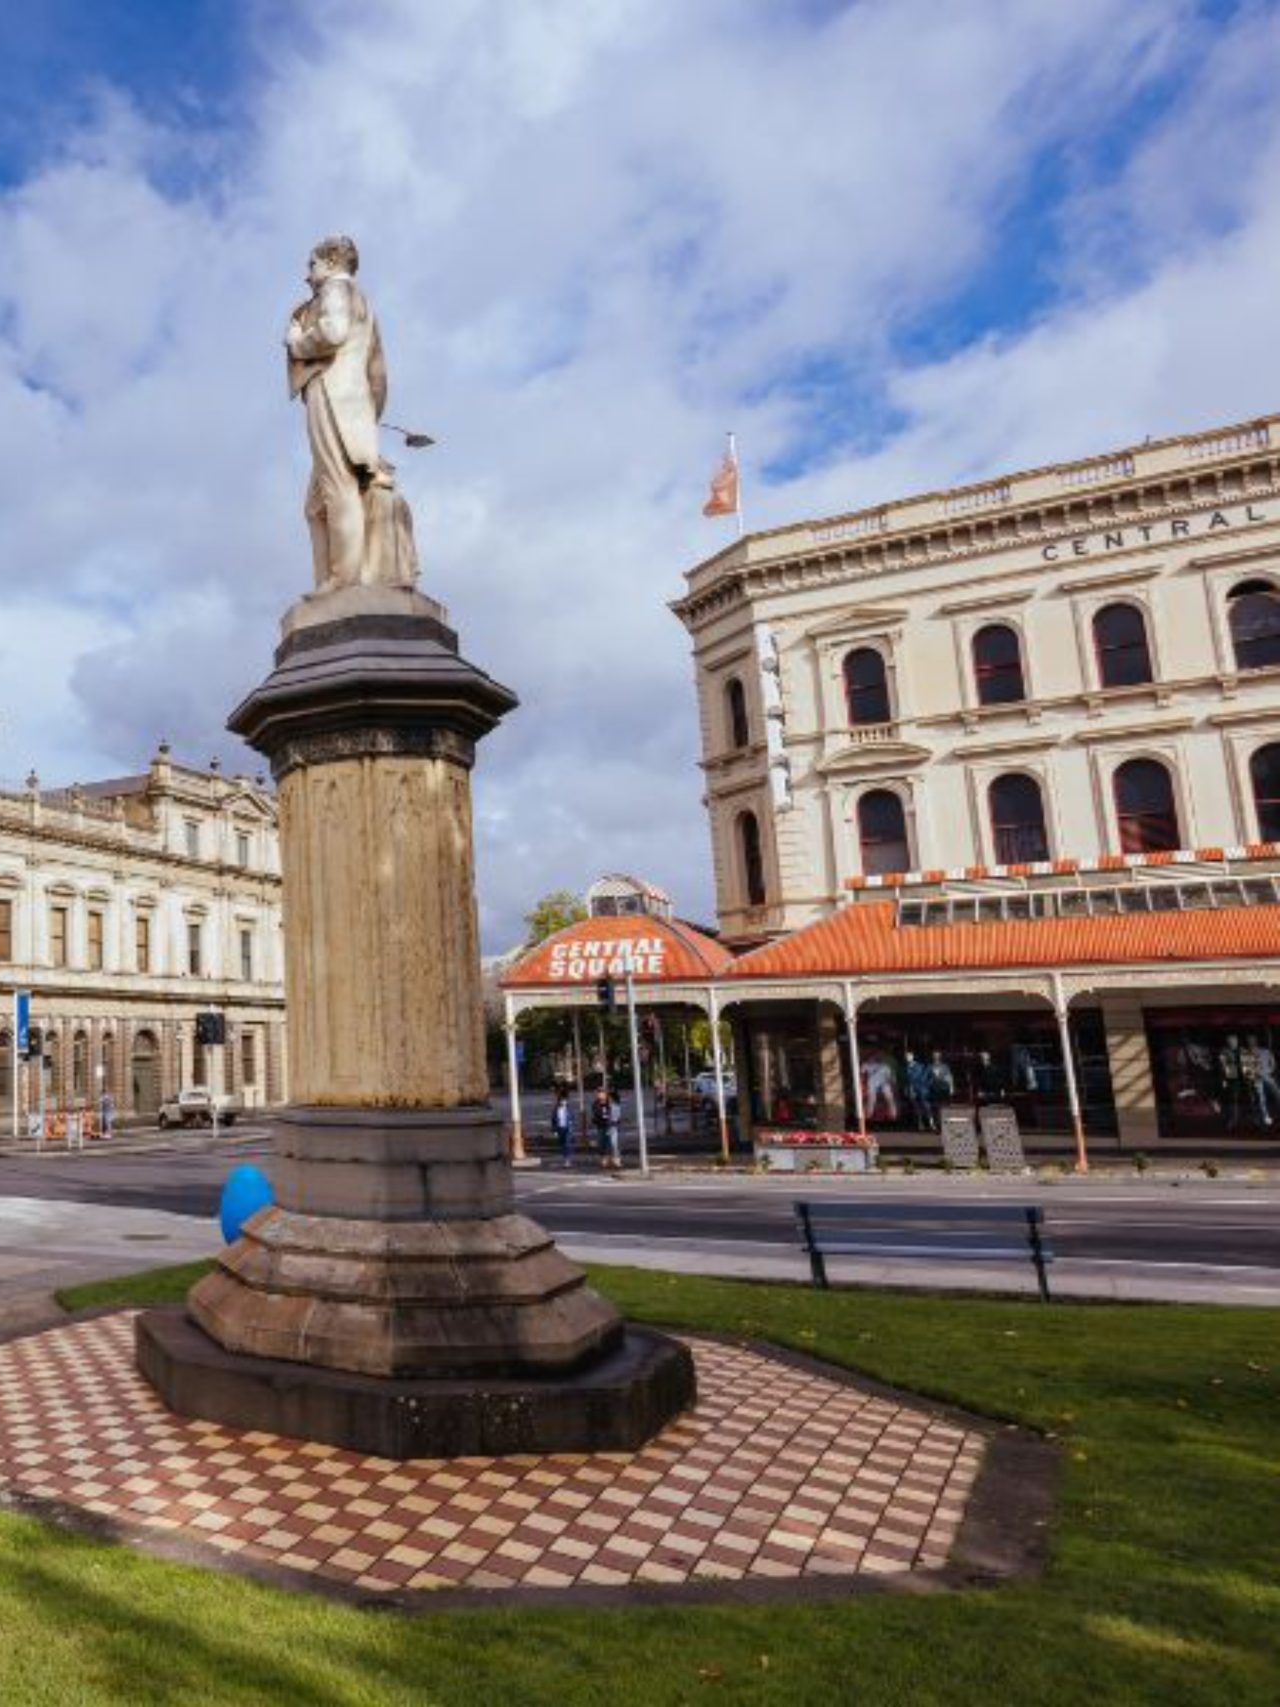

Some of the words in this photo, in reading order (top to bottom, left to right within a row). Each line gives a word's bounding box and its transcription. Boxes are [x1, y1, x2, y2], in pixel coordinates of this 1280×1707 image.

[1041, 506, 1266, 561] CENTRAL
[551, 938, 665, 960] CENTRAL
[548, 955, 664, 979] SQUARE
